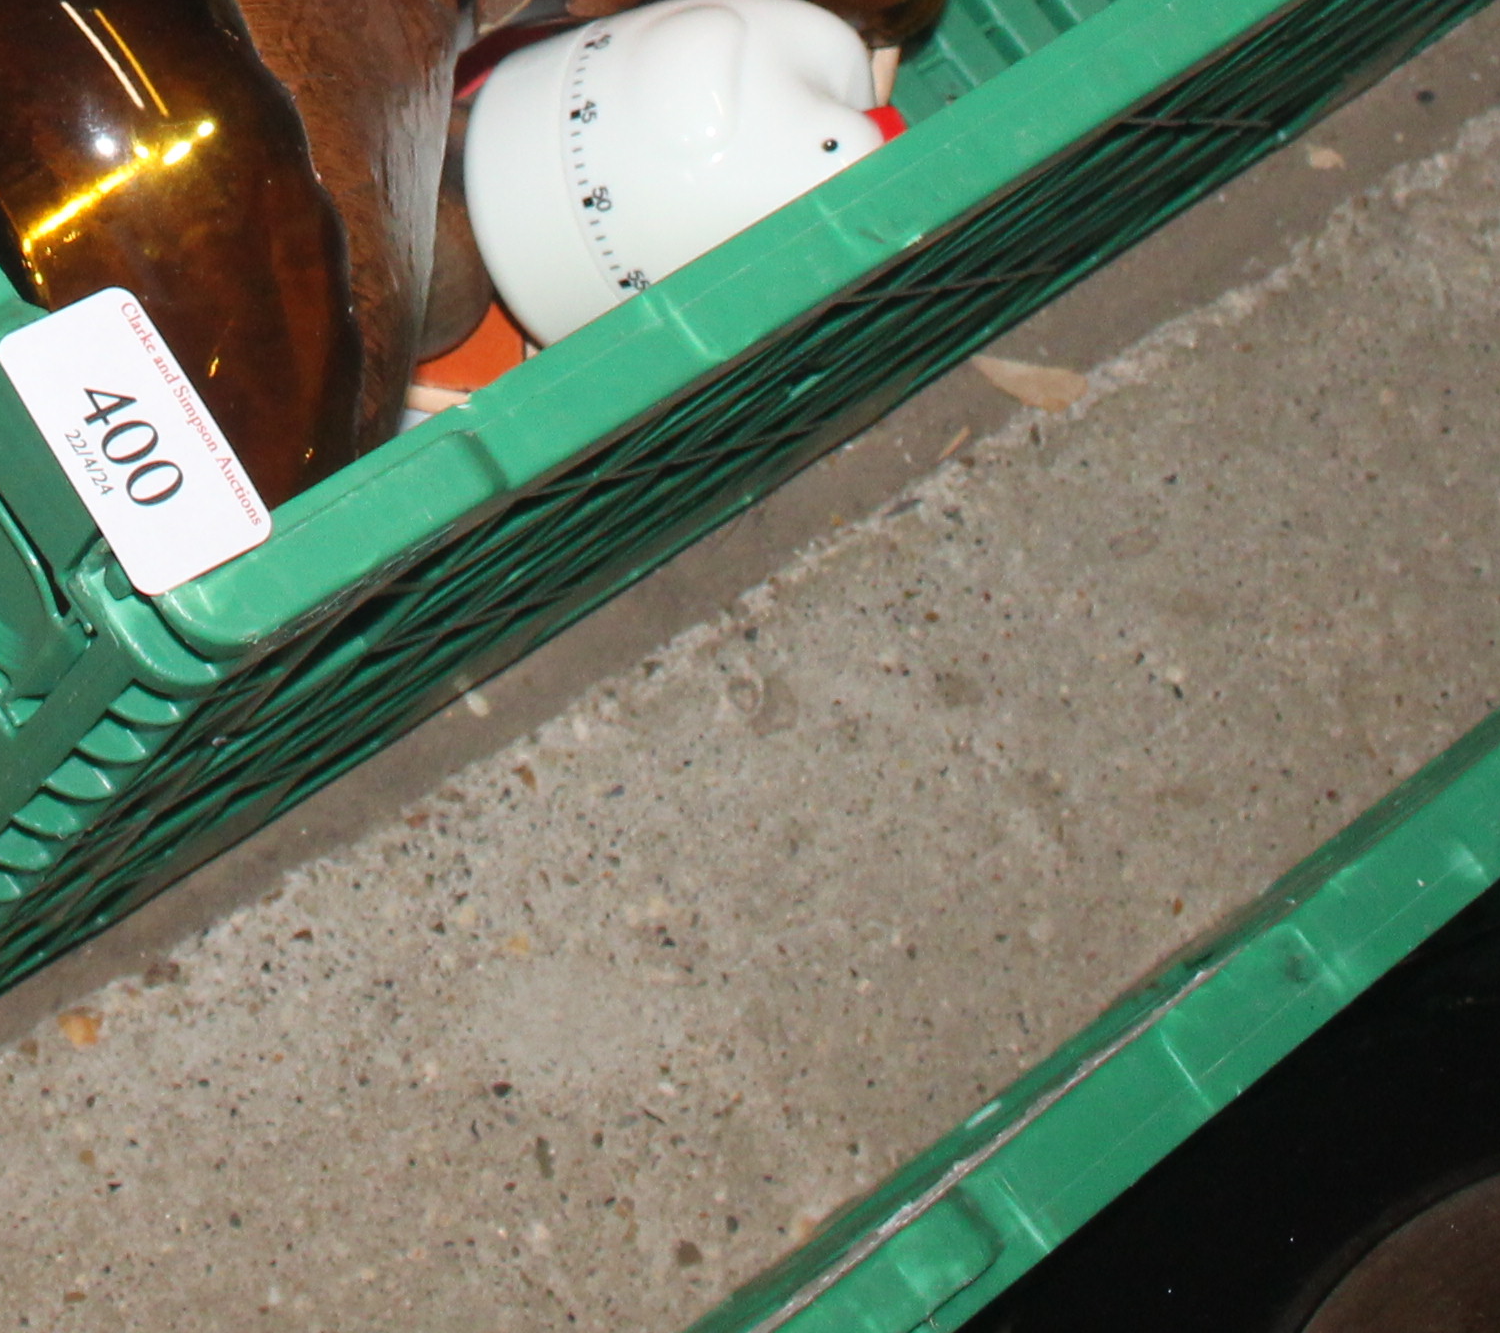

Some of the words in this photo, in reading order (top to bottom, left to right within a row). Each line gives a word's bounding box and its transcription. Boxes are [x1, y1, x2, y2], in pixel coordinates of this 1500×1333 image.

[581, 101, 598, 124] 45
[592, 185, 612, 213] 50
[83, 387, 184, 507] 400
[120, 301, 157, 354] Clarke
[153, 355, 181, 385] and
[172, 383, 219, 453] Simpson
[215, 455, 263, 527] Auctions
[63, 428, 116, 497] 22/4/24
